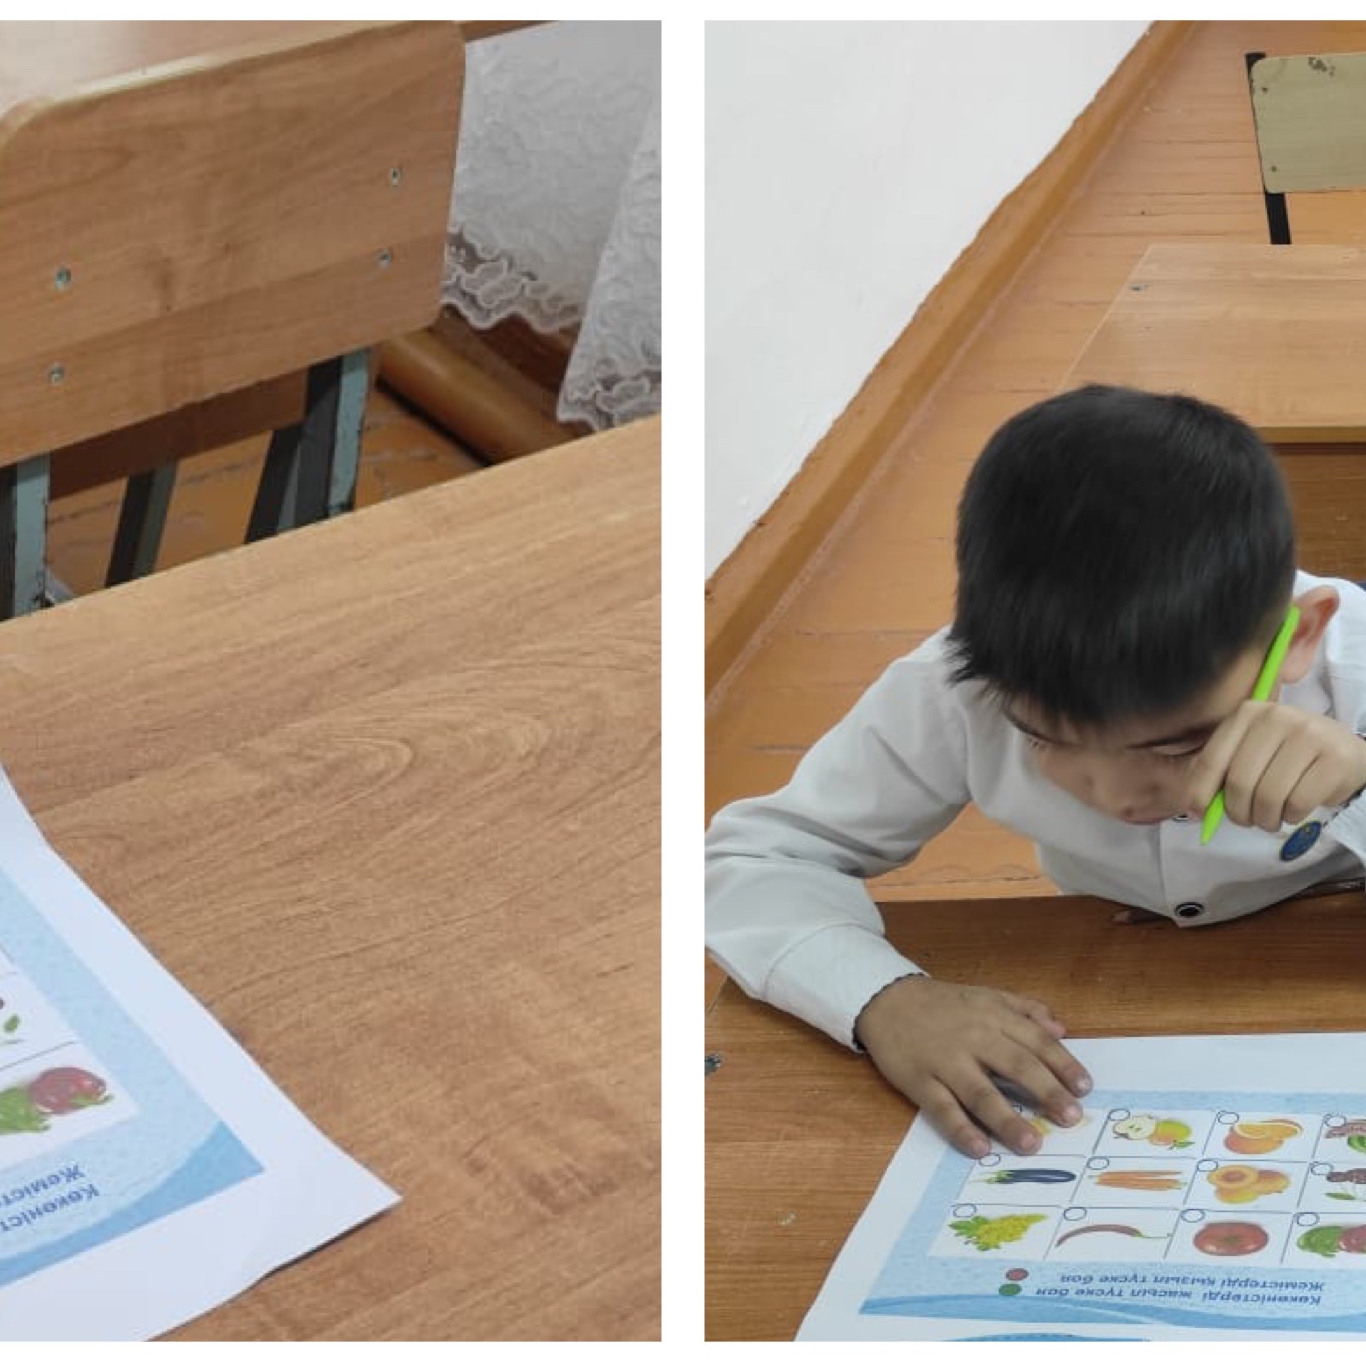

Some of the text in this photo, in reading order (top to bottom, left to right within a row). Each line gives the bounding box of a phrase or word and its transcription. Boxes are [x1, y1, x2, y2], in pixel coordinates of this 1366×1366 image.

[1059, 1272, 1094, 1284] боя
[1220, 1277, 1327, 1293] Жемістерді
[1129, 1286, 1193, 1300] жасыл
